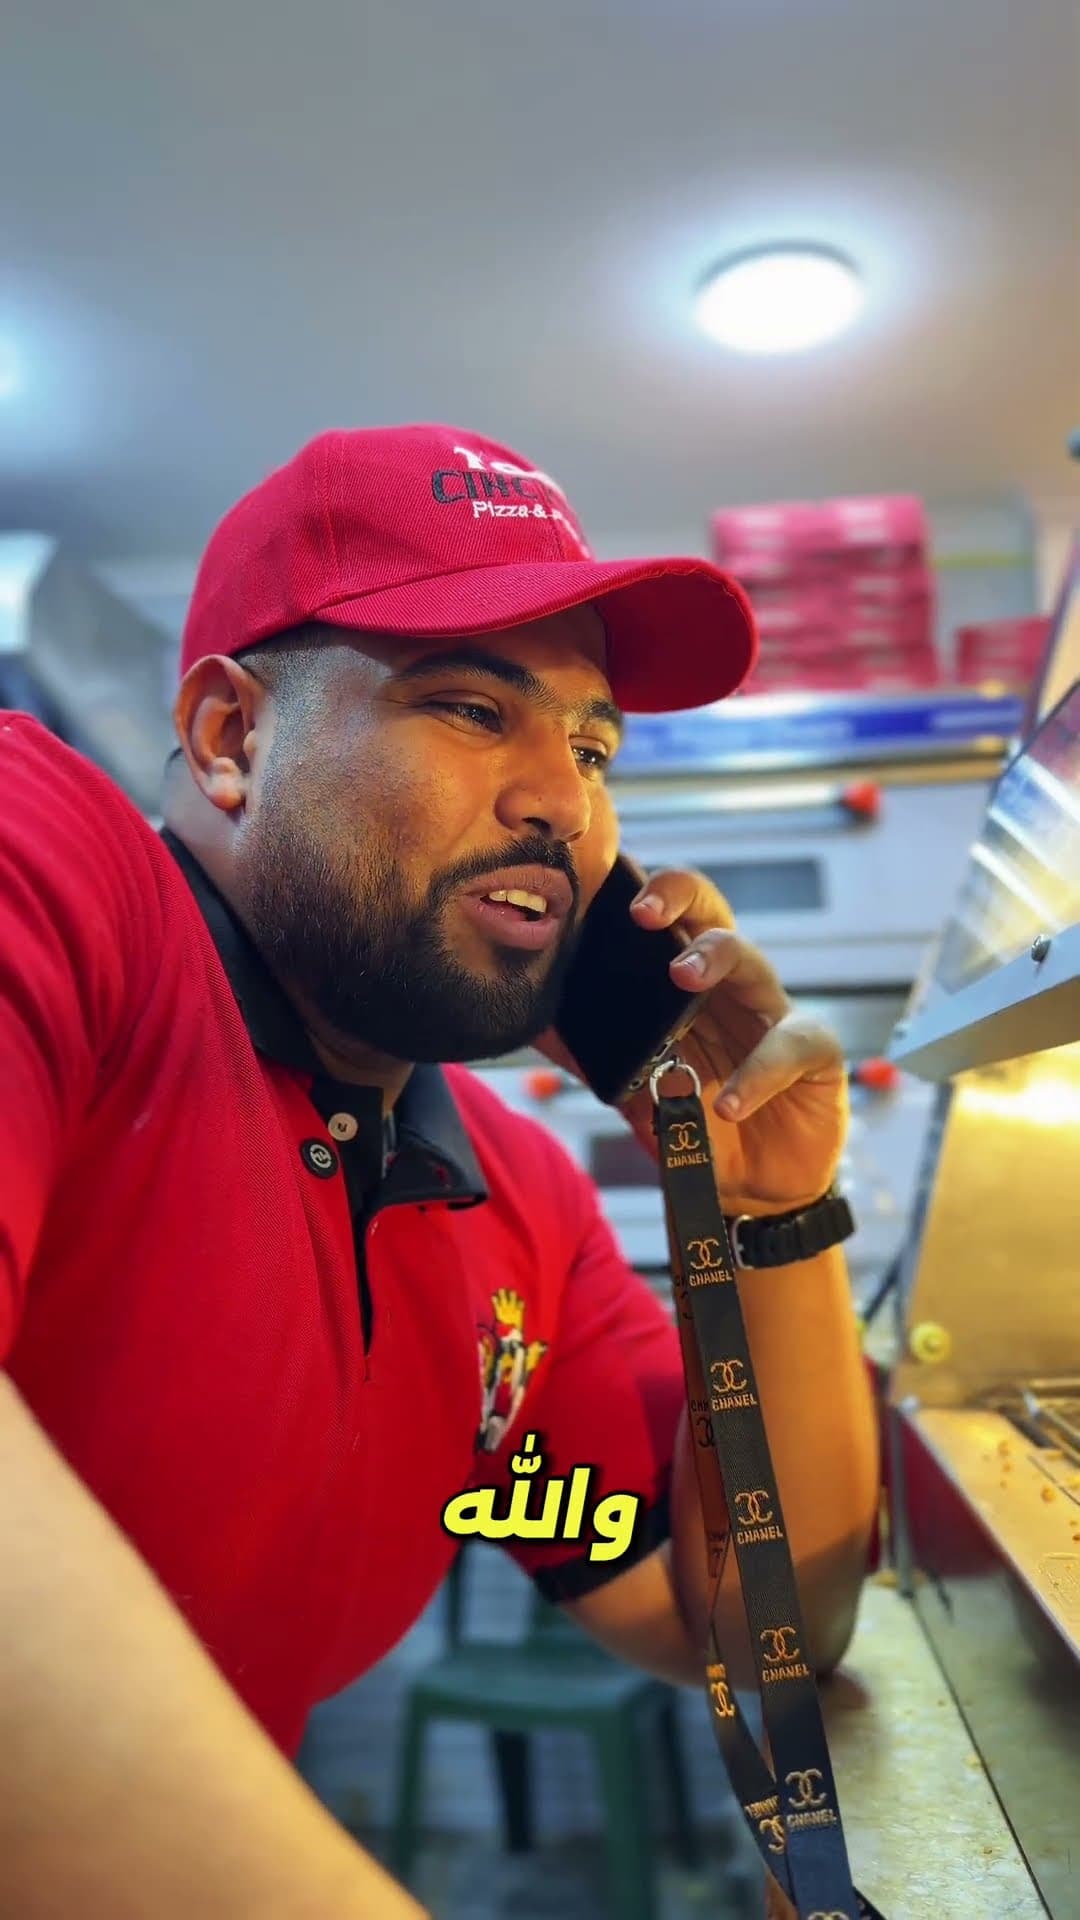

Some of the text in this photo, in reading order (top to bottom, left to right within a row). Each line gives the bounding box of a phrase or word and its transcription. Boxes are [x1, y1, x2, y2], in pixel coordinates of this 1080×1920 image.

[472, 501, 529, 519] Pizza
[667, 1152, 710, 1168] CHANEL
[689, 1269, 733, 1286] CHANEL
[711, 1393, 757, 1412] CHANEL
[736, 1525, 784, 1545] CHANEL
[762, 1663, 810, 1682] CHANEL
[786, 1808, 837, 1829] CHANEL
